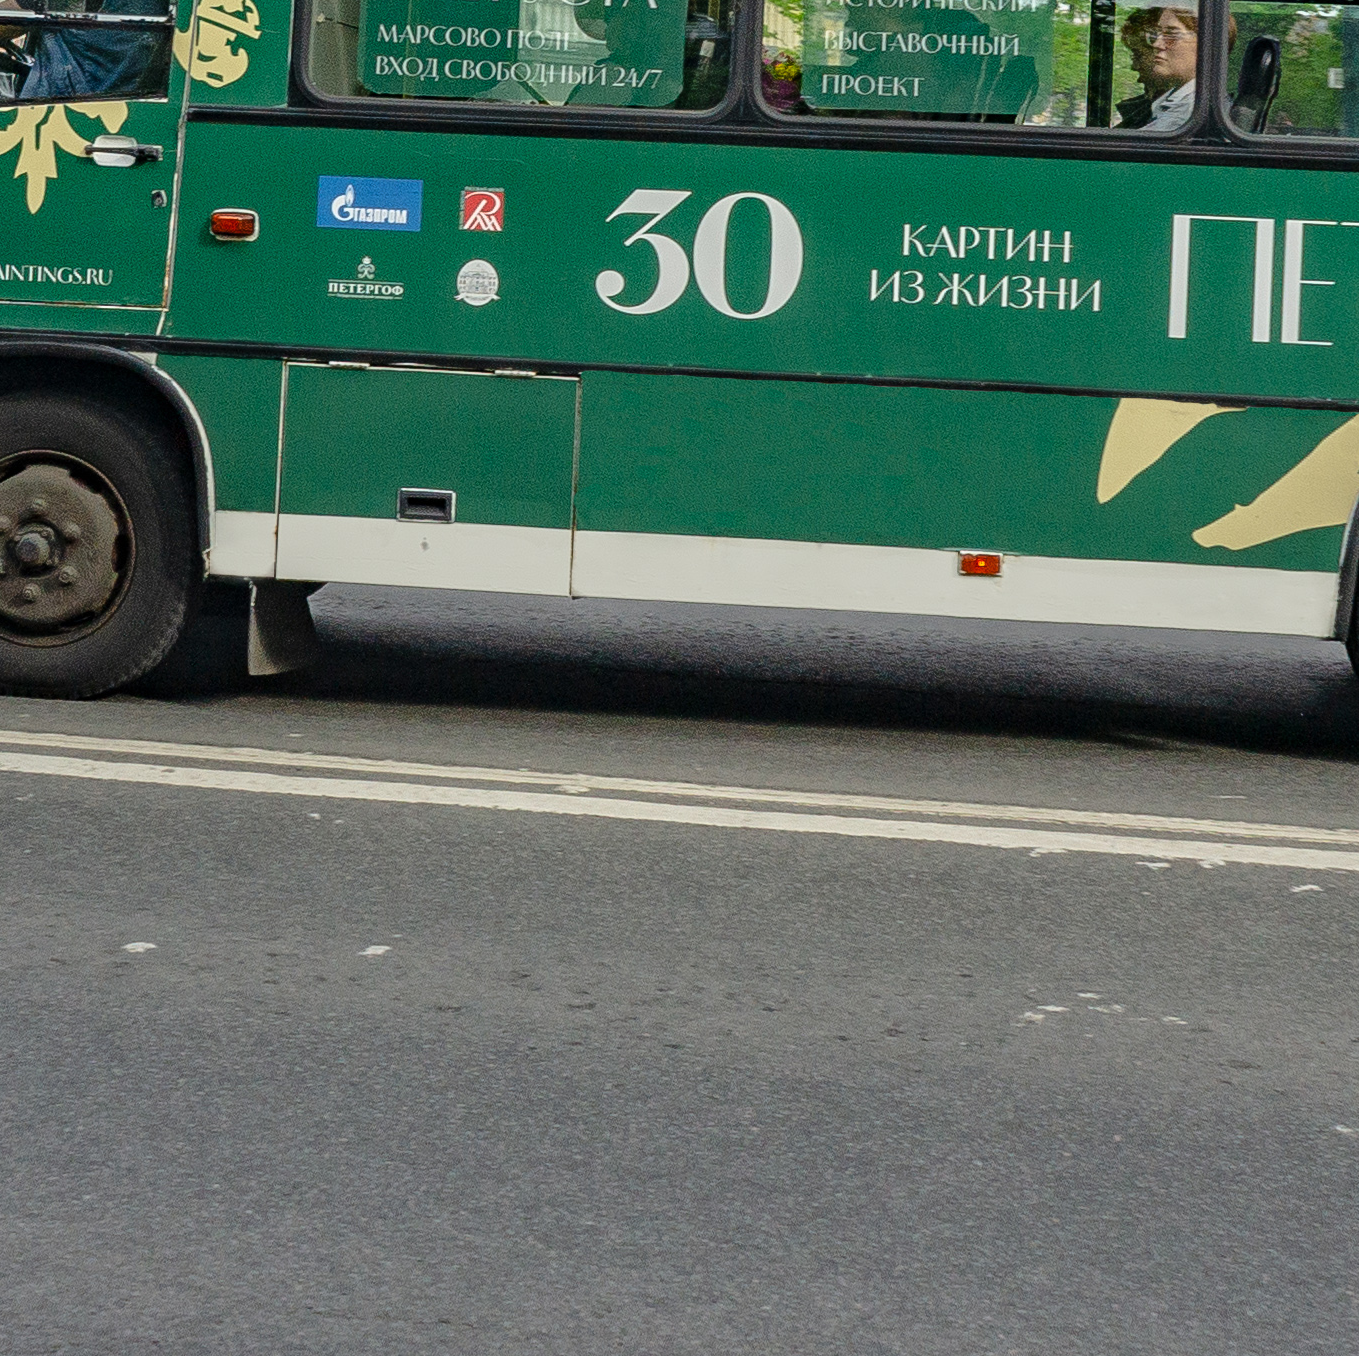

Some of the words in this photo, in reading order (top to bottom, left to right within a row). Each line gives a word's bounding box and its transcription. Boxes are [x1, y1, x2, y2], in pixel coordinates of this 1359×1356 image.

[377, 23, 501, 49] МАРСОВО
[506, 29, 580, 52] ПОЛЕ
[823, 30, 1021, 57] ВЫСТАВОЧНЫЙ
[374, 55, 440, 81] ВХОД
[443, 59, 607, 87] СВОБОДНЫЙ
[611, 66, 664, 90] 24/7
[821, 73, 926, 98] ПРОЕКТ
[594, 188, 804, 321] 30
[901, 223, 1074, 263] КАРТИН
[327, 282, 404, 296] ПЕТЕРГОФ
[869, 268, 926, 305] ИЗ
[933, 272, 1103, 313] ЖИЗНИ
